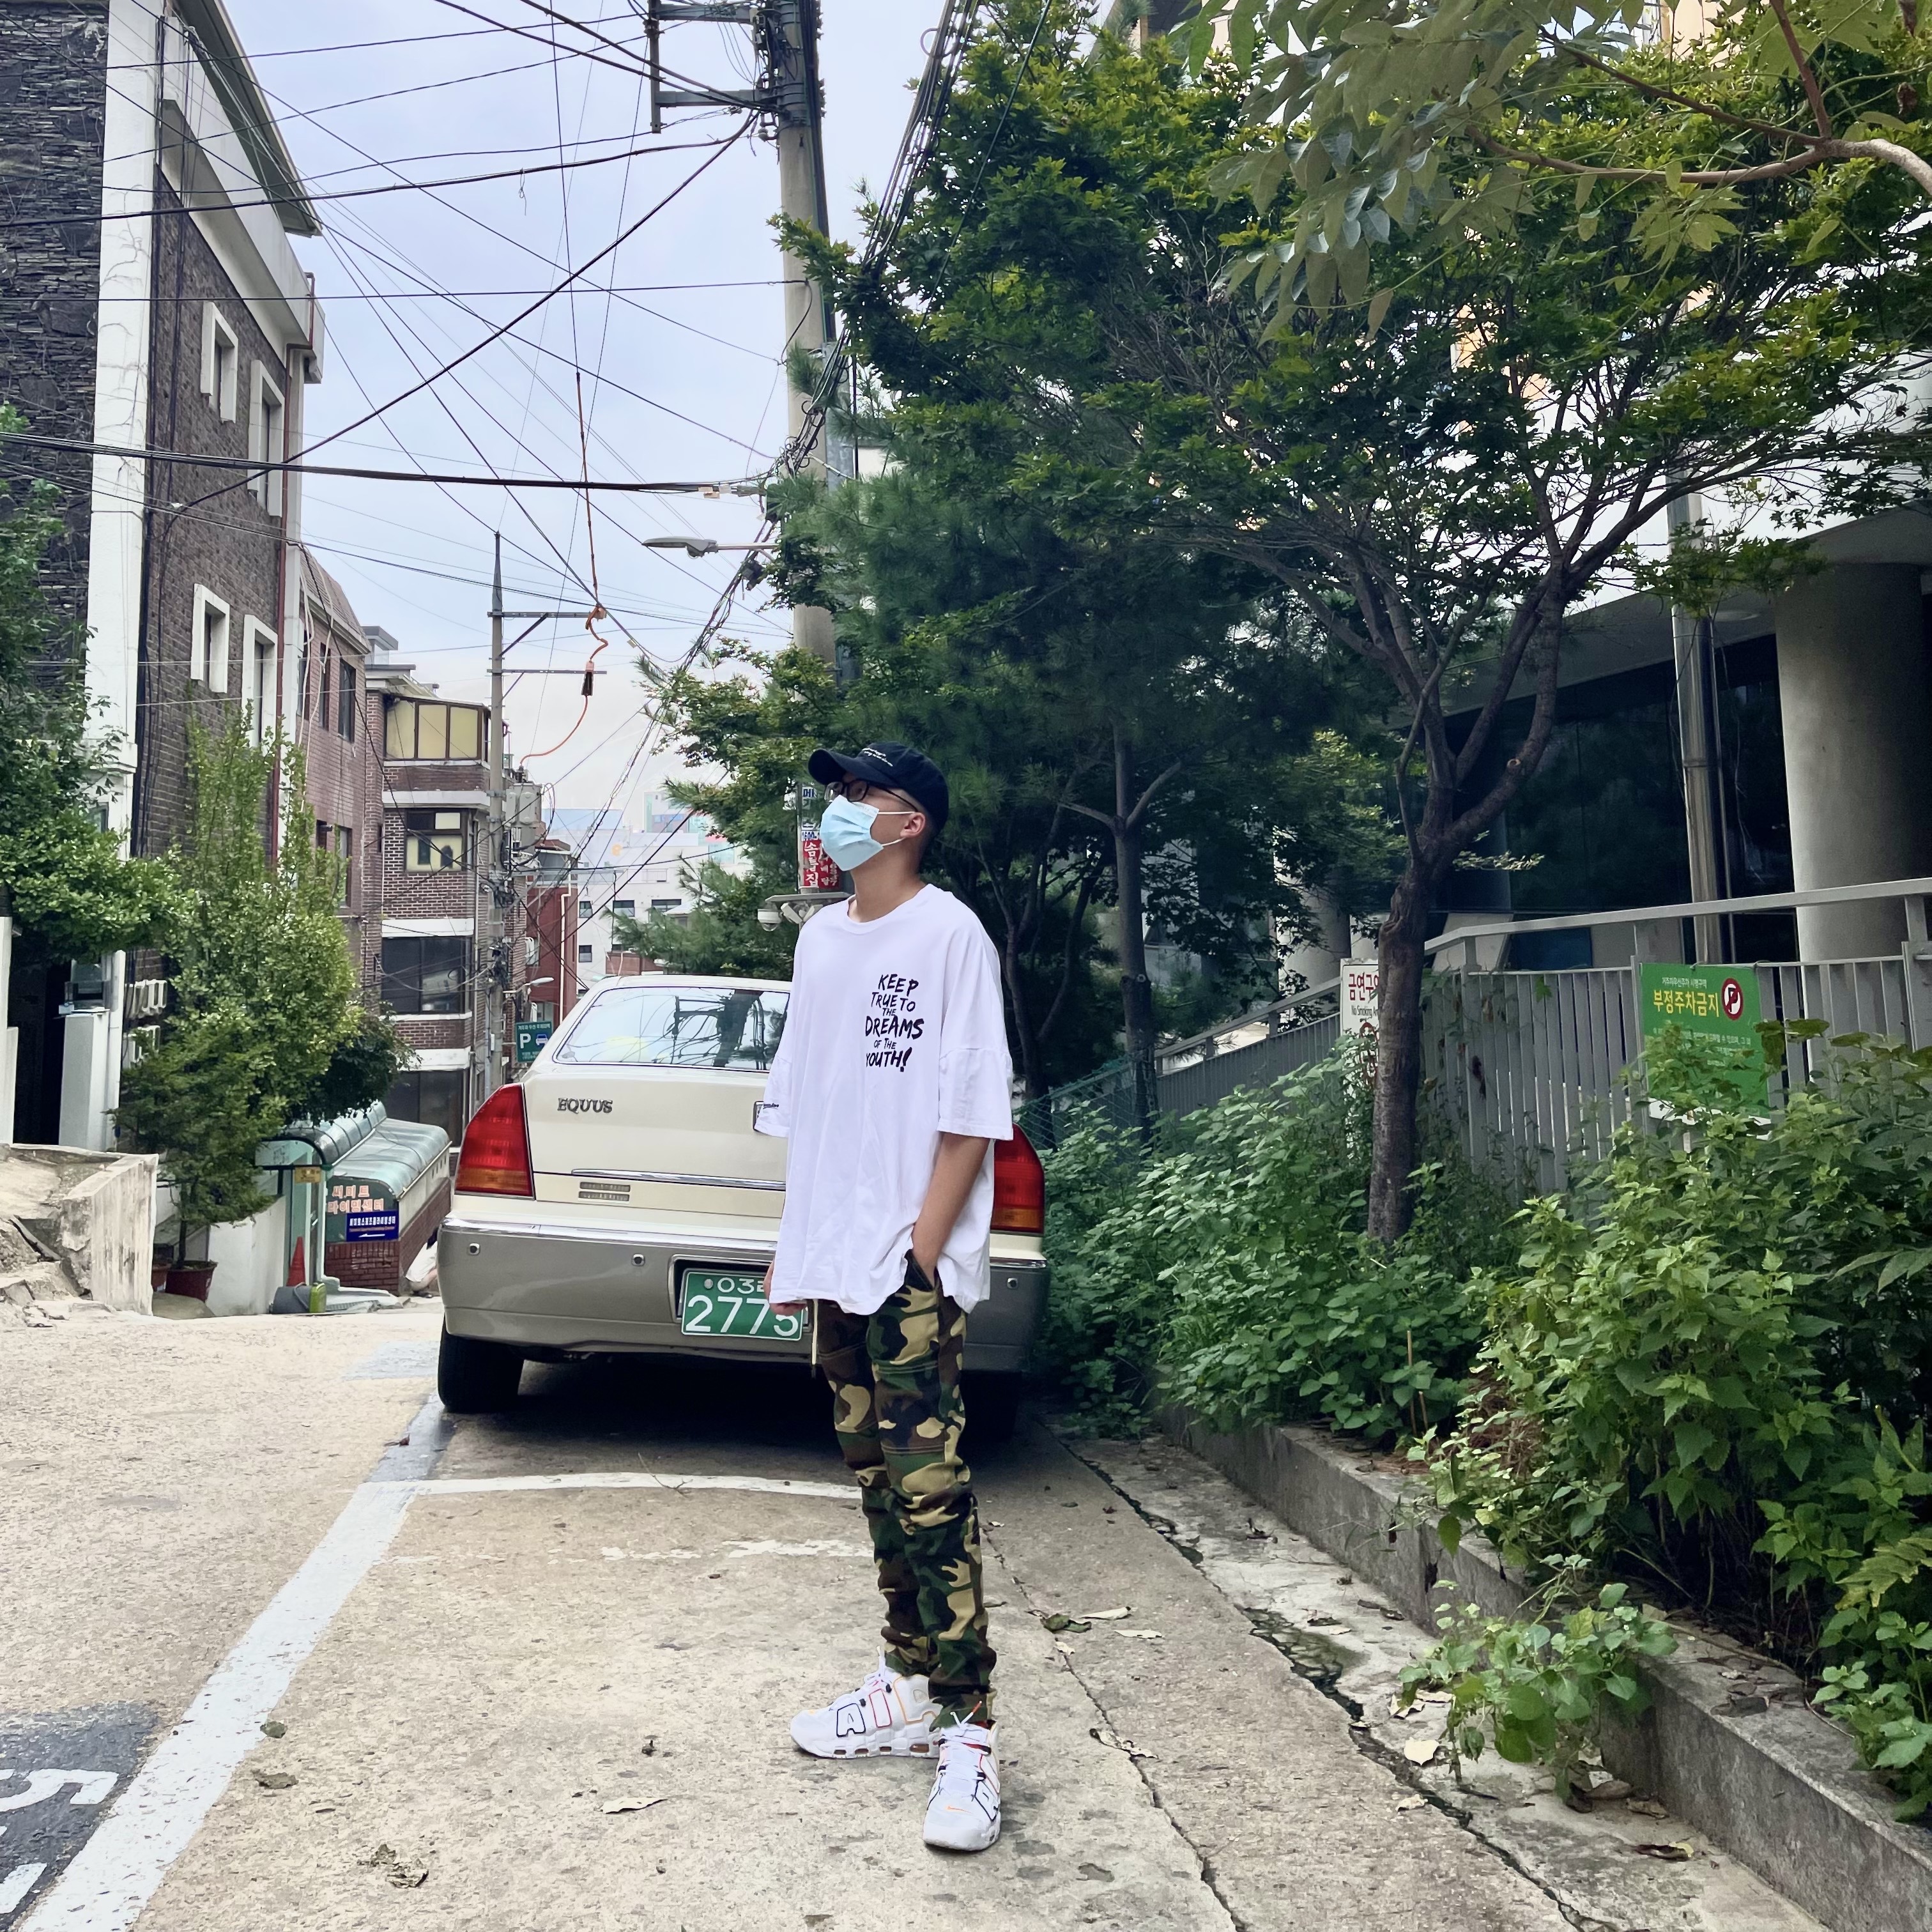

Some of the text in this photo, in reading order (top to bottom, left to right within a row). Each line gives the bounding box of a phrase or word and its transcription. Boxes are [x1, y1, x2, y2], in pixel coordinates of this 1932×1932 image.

[878, 974, 919, 997] KEEP
[871, 992, 916, 1012] TRUE TO
[882, 1008, 896, 1016] THE
[1351, 1004, 1356, 1015] No
[1357, 1005, 1372, 1018] Smoking
[1653, 990, 1719, 1017] 부정주차금지
[866, 1015, 924, 1039] DREAMS
[520, 1034, 531, 1048] P
[874, 1038, 896, 1049] OF THE
[866, 1047, 912, 1072] YOUTH!
[557, 1098, 613, 1114] EQUUS
[686, 1294, 799, 1337] 2775
